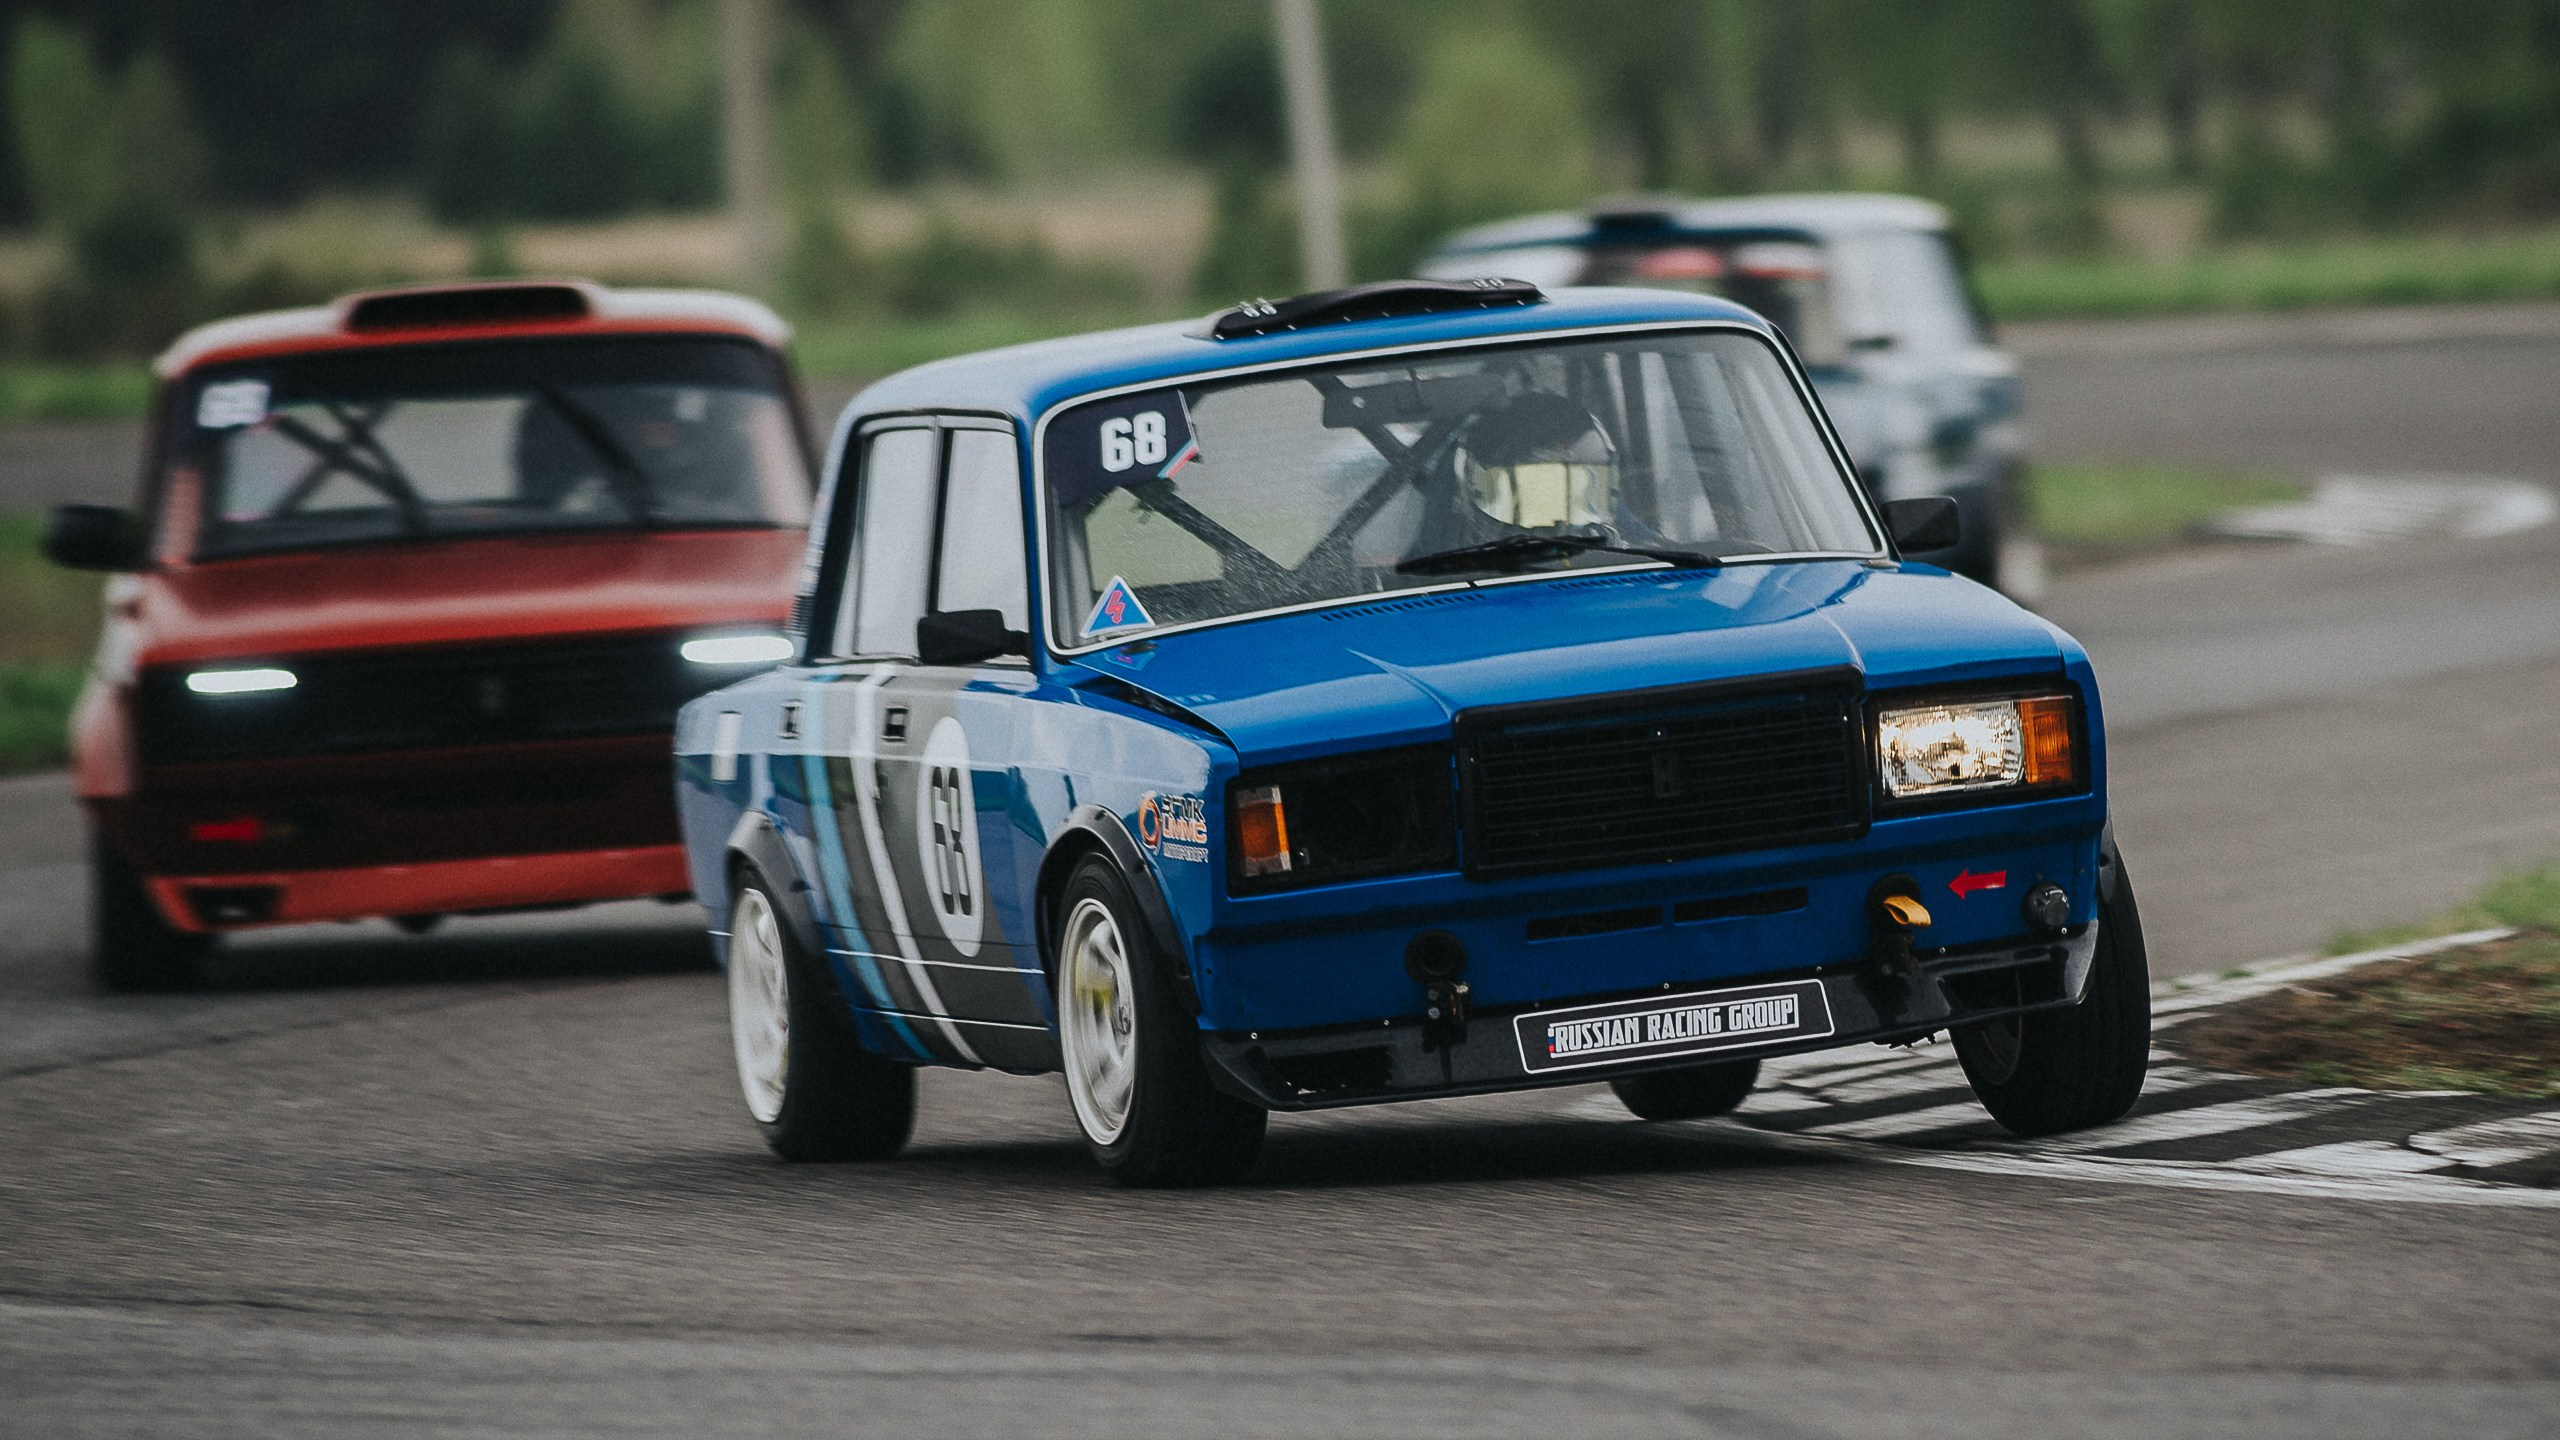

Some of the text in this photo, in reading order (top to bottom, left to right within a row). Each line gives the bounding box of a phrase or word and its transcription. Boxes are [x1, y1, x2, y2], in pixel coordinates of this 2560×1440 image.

[1101, 411, 1167, 473] 68
[932, 766, 972, 916] 68
[1554, 998, 1794, 1053] RUSSIAN RACING GROUP
